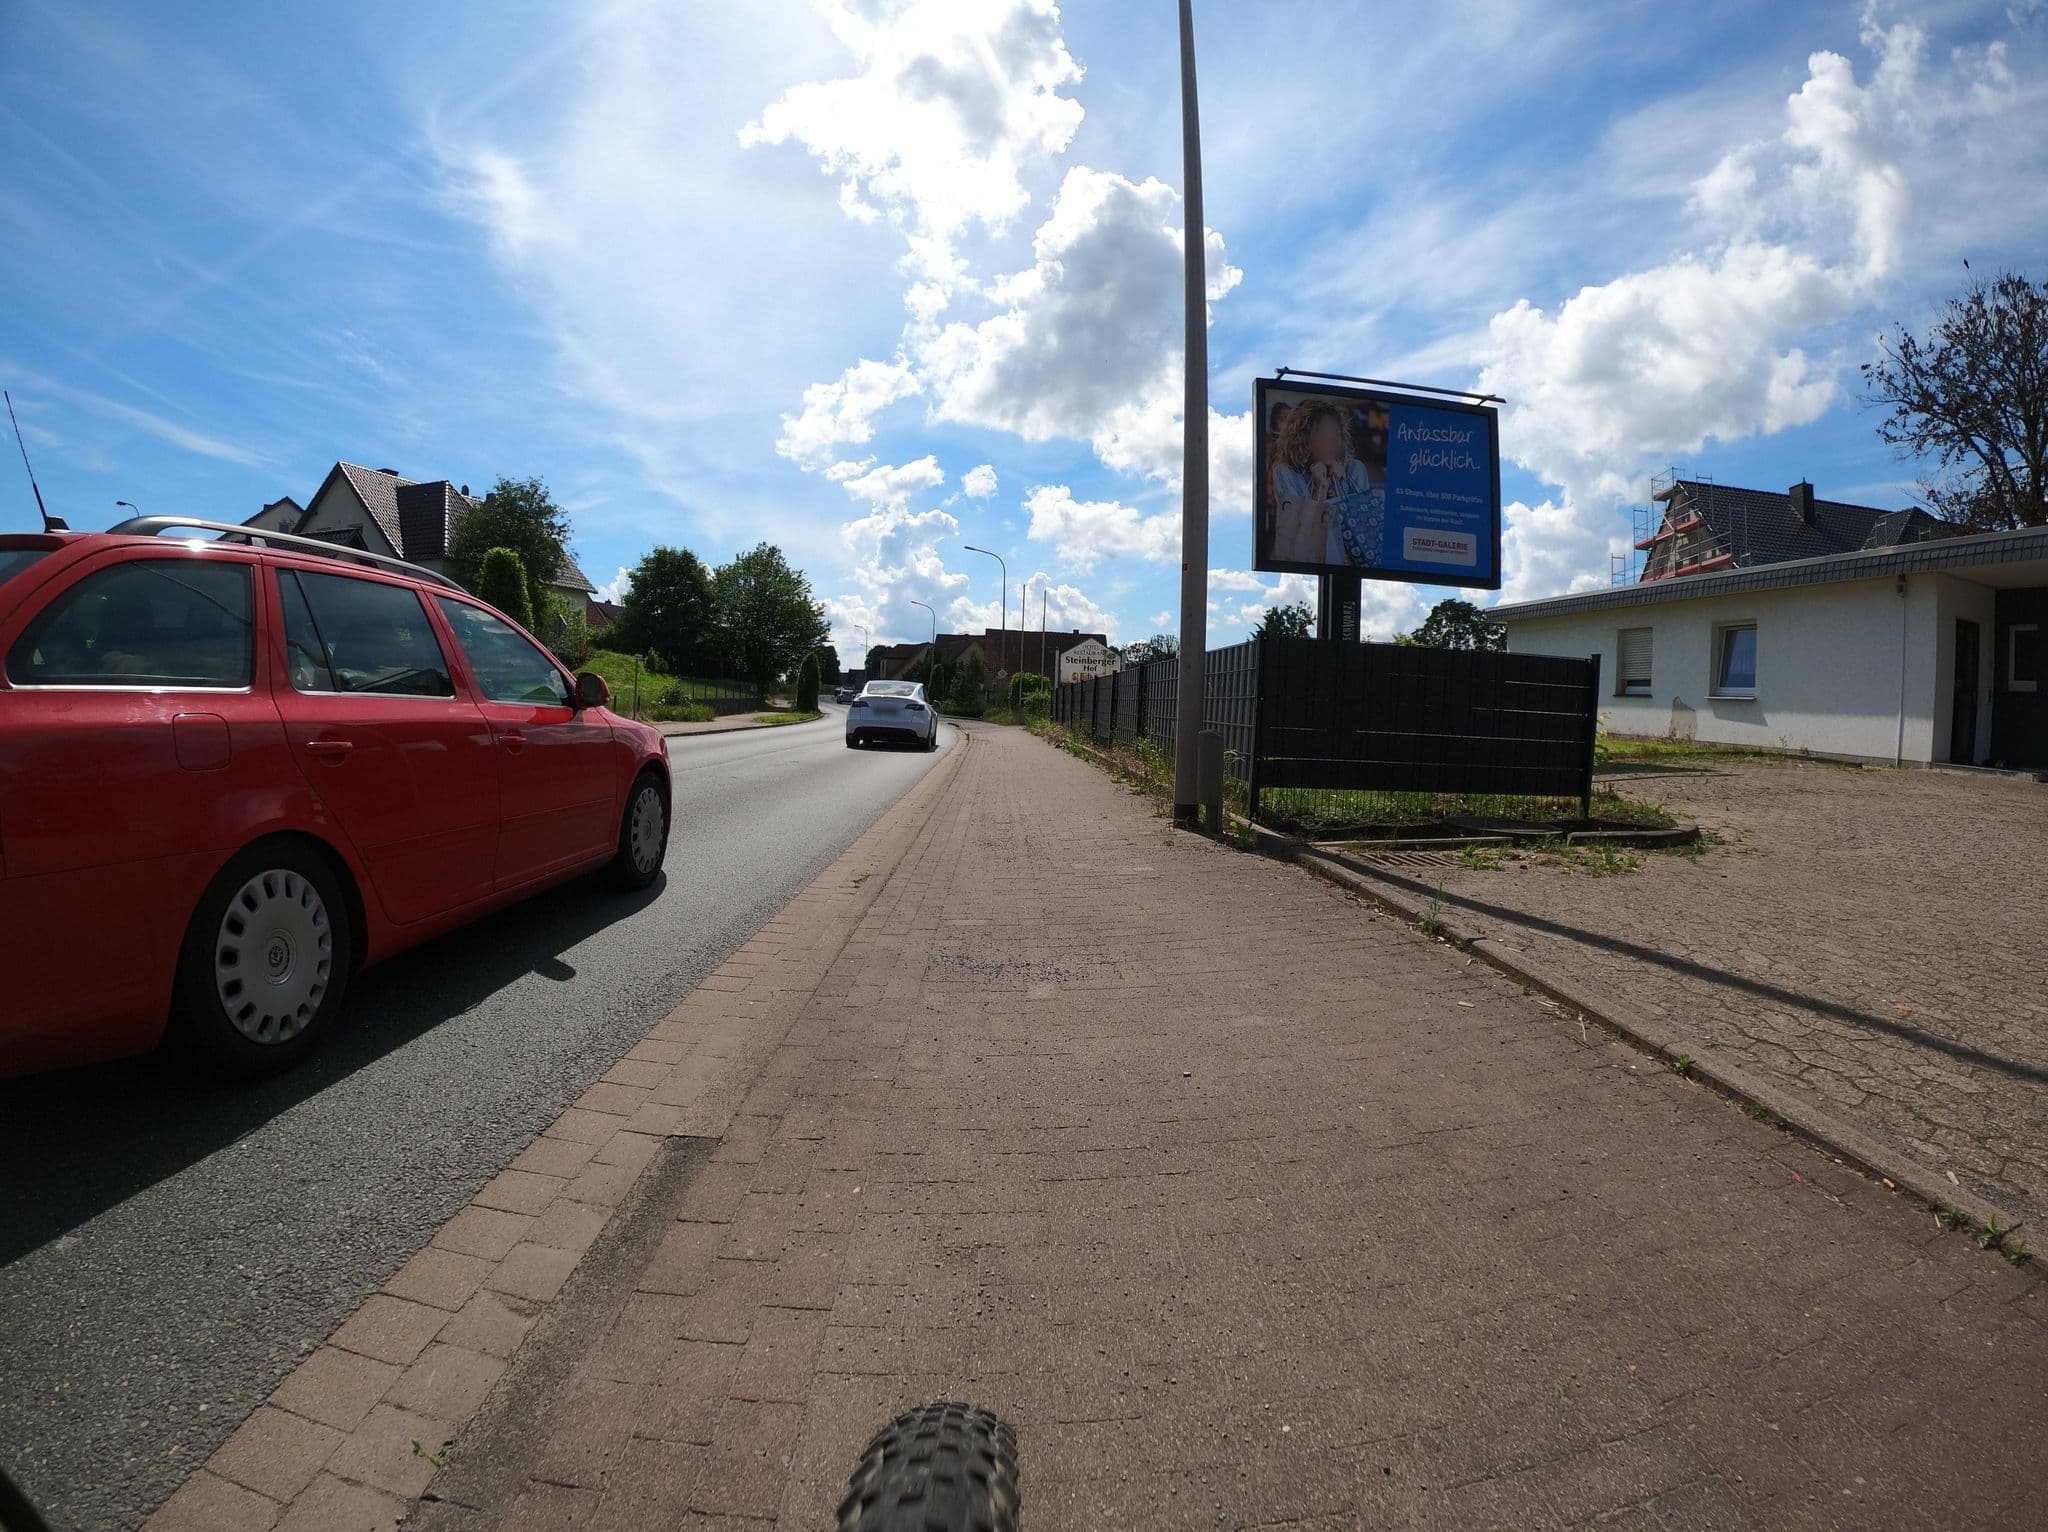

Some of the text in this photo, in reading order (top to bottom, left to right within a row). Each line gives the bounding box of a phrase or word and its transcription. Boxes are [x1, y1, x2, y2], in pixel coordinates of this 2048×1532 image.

[1397, 421, 1473, 443] Anfassbar
[1409, 448, 1481, 474] glücklich.
[1412, 538, 1468, 550] STADT-GALERIE
[1065, 656, 1116, 666] Steinberger
